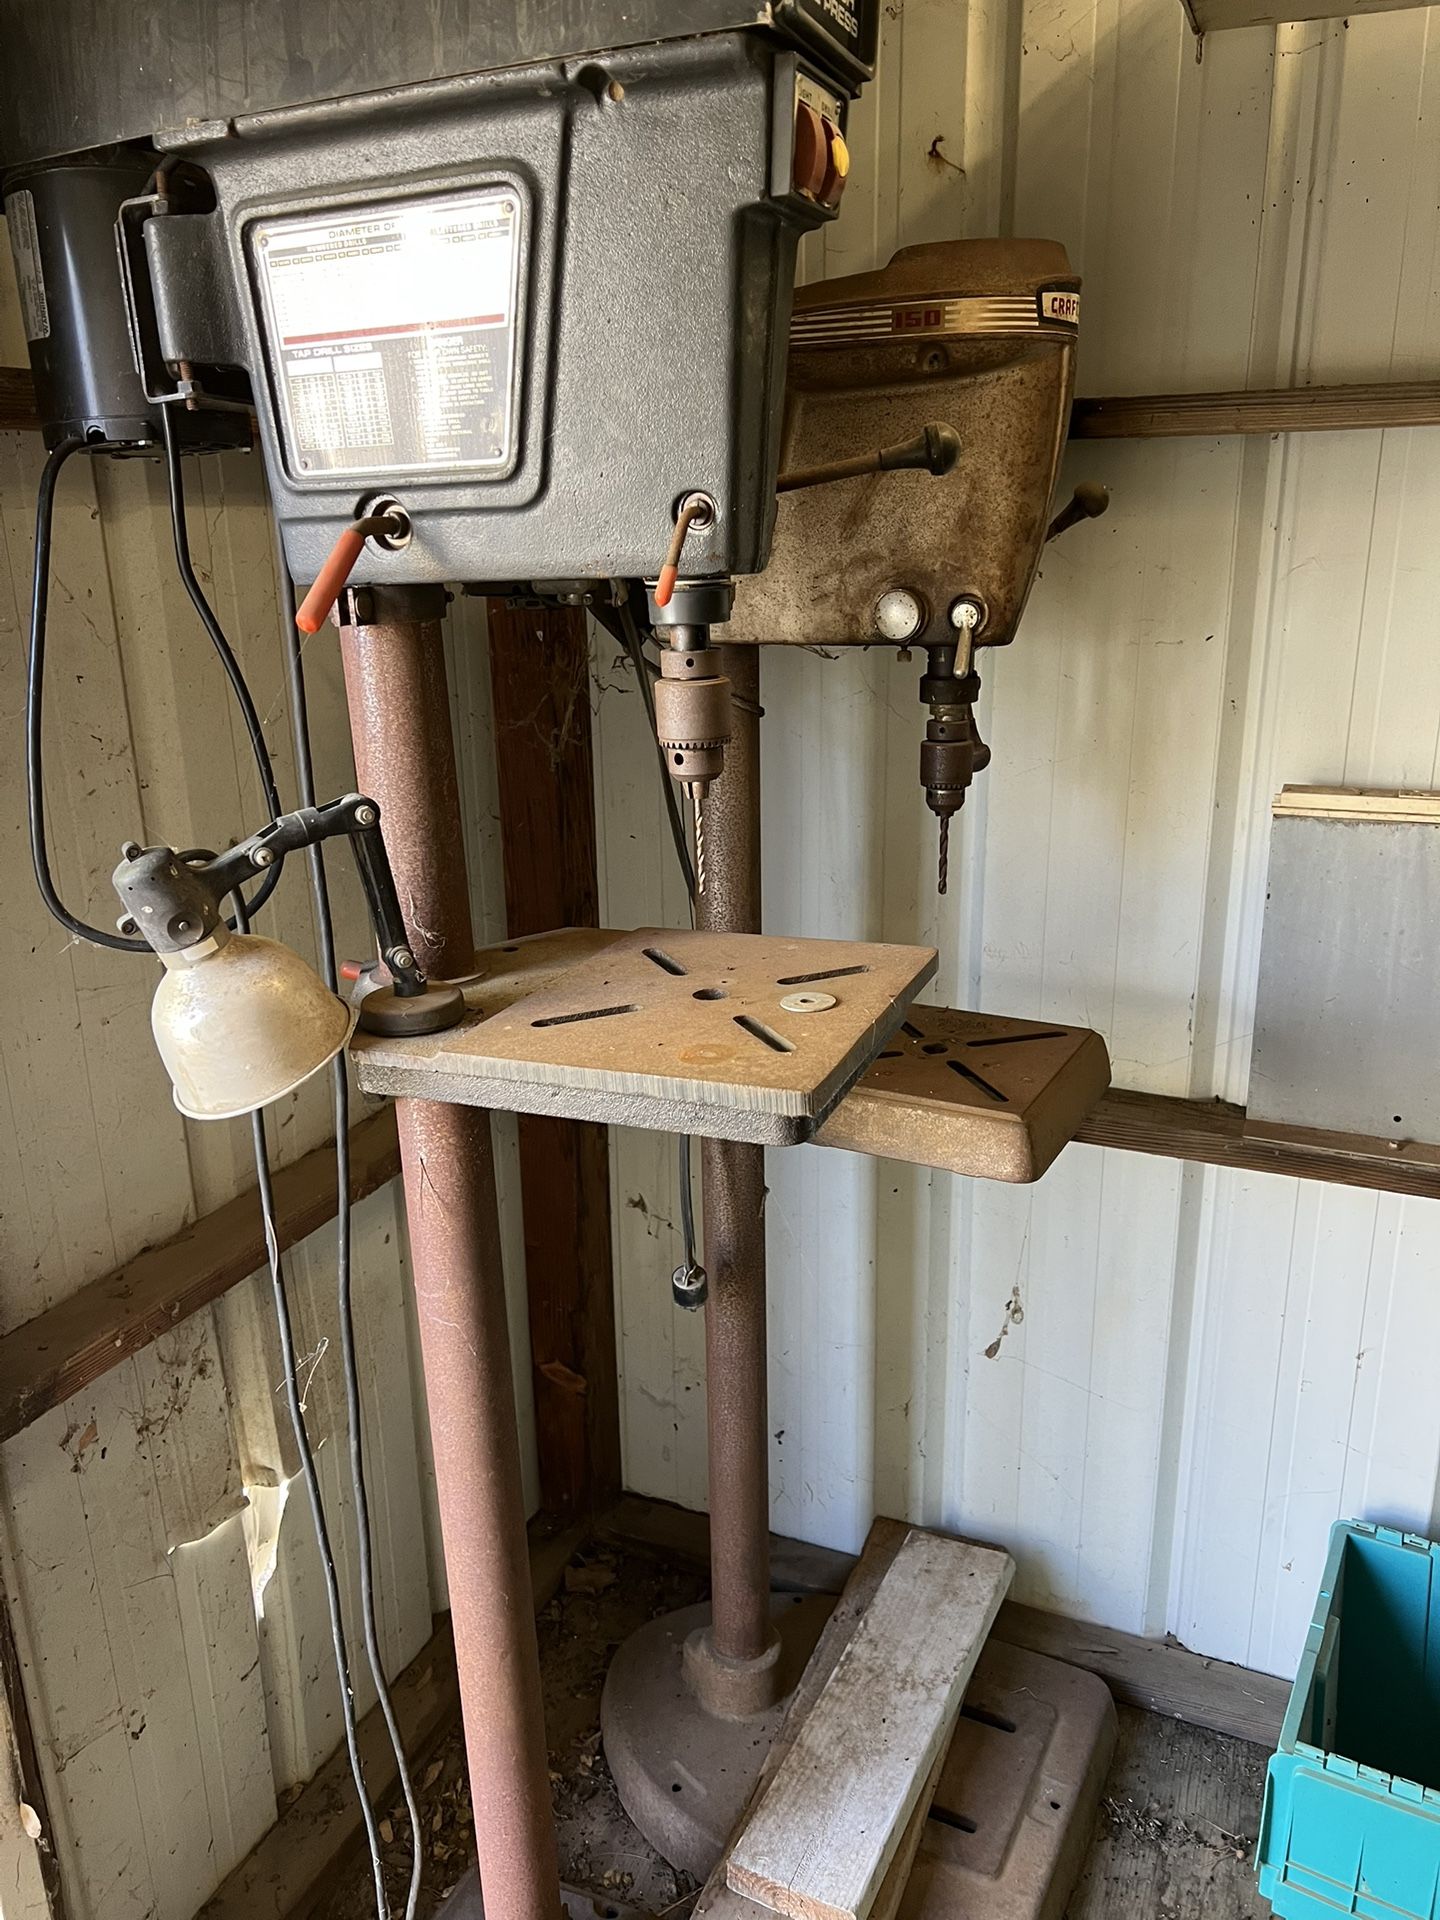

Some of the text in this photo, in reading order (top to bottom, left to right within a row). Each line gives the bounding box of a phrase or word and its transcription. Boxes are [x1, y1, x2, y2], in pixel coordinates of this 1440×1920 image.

[823, 0, 858, 38] PRESS
[328, 224, 380, 239] DIAMETER
[895, 310, 941, 328] 150
[291, 349, 311, 359] TAP
[312, 345, 343, 357] DRILL
[460, 343, 488, 354] SAFETY:
